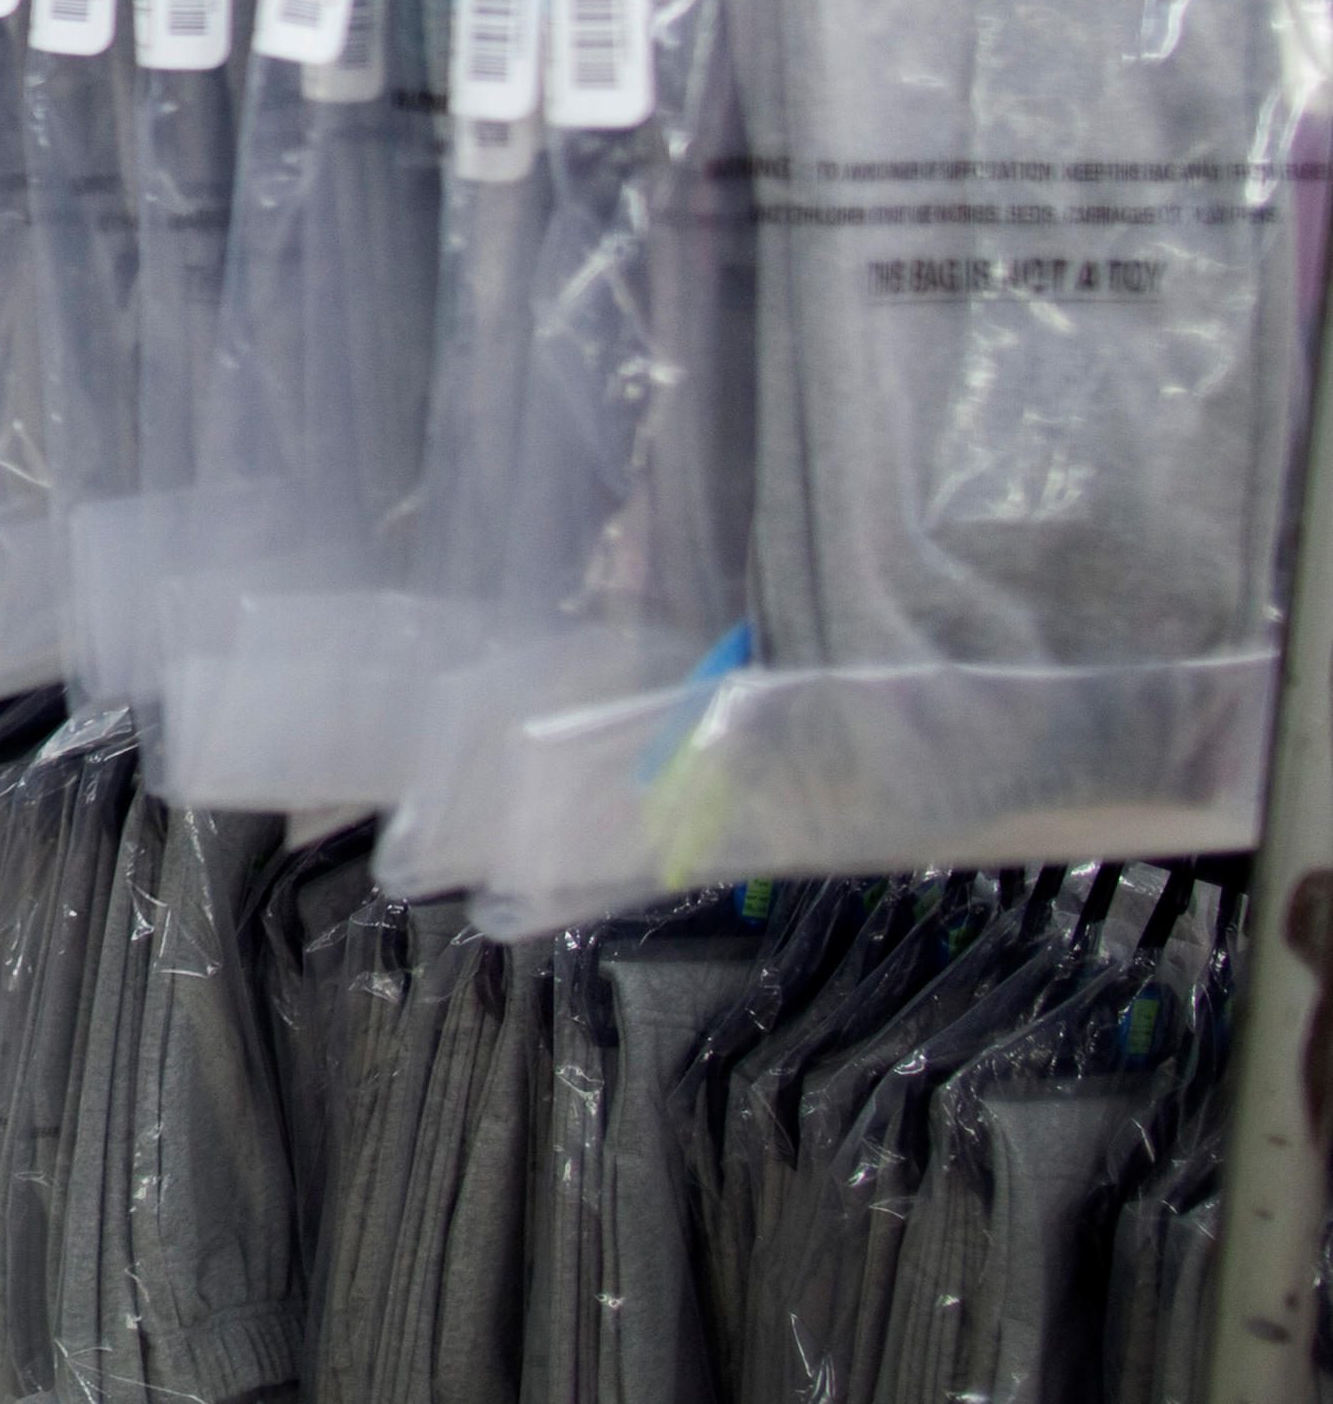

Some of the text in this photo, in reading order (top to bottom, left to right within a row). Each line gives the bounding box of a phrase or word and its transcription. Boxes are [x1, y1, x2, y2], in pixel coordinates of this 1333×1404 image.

[910, 259, 959, 293] BAG
[1075, 261, 1098, 289] A
[1107, 260, 1165, 293] TOY
